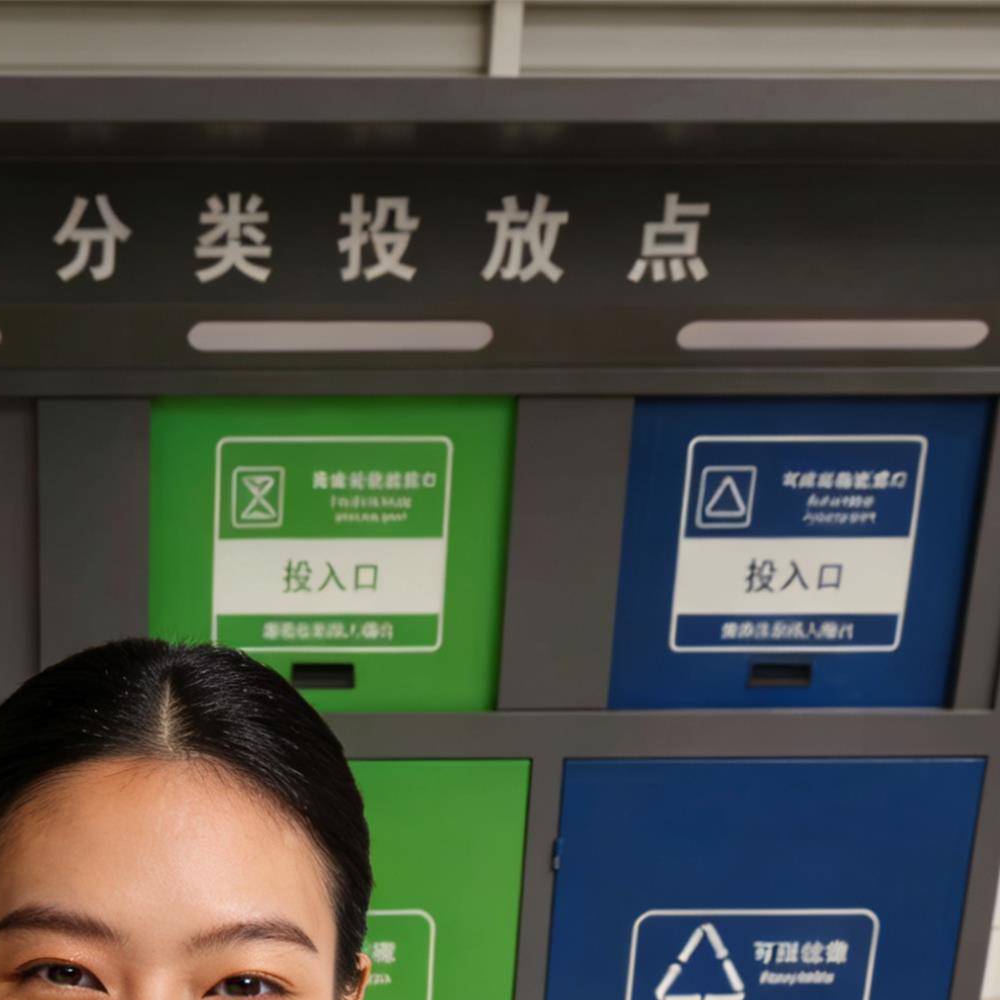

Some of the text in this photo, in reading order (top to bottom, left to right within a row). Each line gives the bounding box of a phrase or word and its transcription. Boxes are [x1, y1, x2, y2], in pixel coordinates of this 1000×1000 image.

[282, 559, 379, 593] 投入口
[745, 558, 843, 593] 投入口
